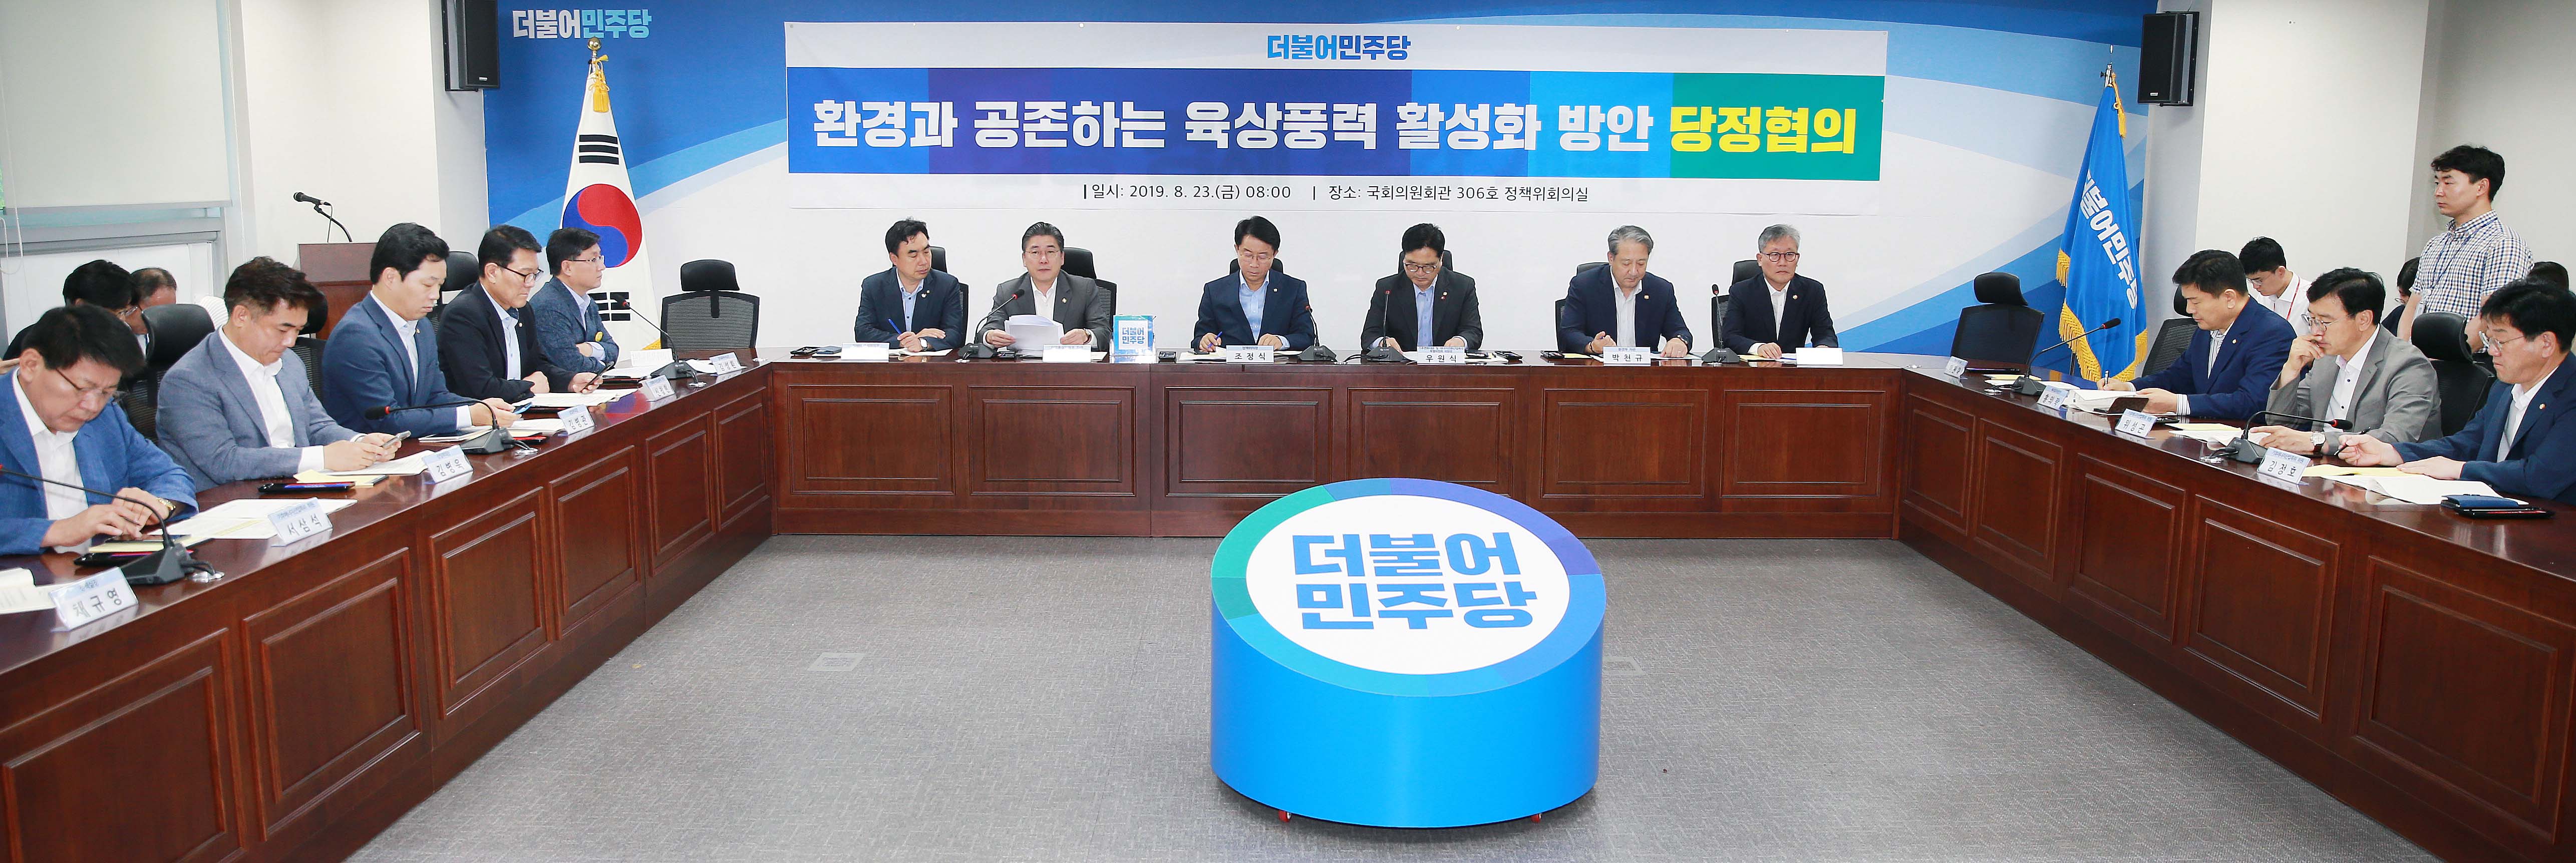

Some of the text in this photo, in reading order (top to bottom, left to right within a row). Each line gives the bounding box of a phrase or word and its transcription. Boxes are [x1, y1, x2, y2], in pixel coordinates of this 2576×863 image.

[512, 9, 652, 39] 더불어민주당
[1267, 35, 1411, 60] 더불어민주당
[814, 100, 1856, 154] 환경과 공존하는 육상풍력 활성화 방안 당정협의
[1092, 184, 1291, 200] 일시: 2019. 8. 23.(금) 08:00
[1329, 185, 1587, 202] 장소: 국회의원회관 306호 정책위회의실
[1122, 327, 1144, 335] 더불어
[1122, 336, 1145, 344] 민주당
[1234, 352, 1265, 360] 조정식
[1426, 355, 1457, 363] 우원식
[1612, 354, 1643, 362] 박천규
[2123, 419, 2146, 434] 위성곤
[436, 459, 465, 477] 김병욱
[2268, 460, 2297, 477] 김정호
[287, 513, 323, 537] 서삼석
[1292, 532, 1520, 577] 더불어
[1296, 581, 1537, 630] 민주당
